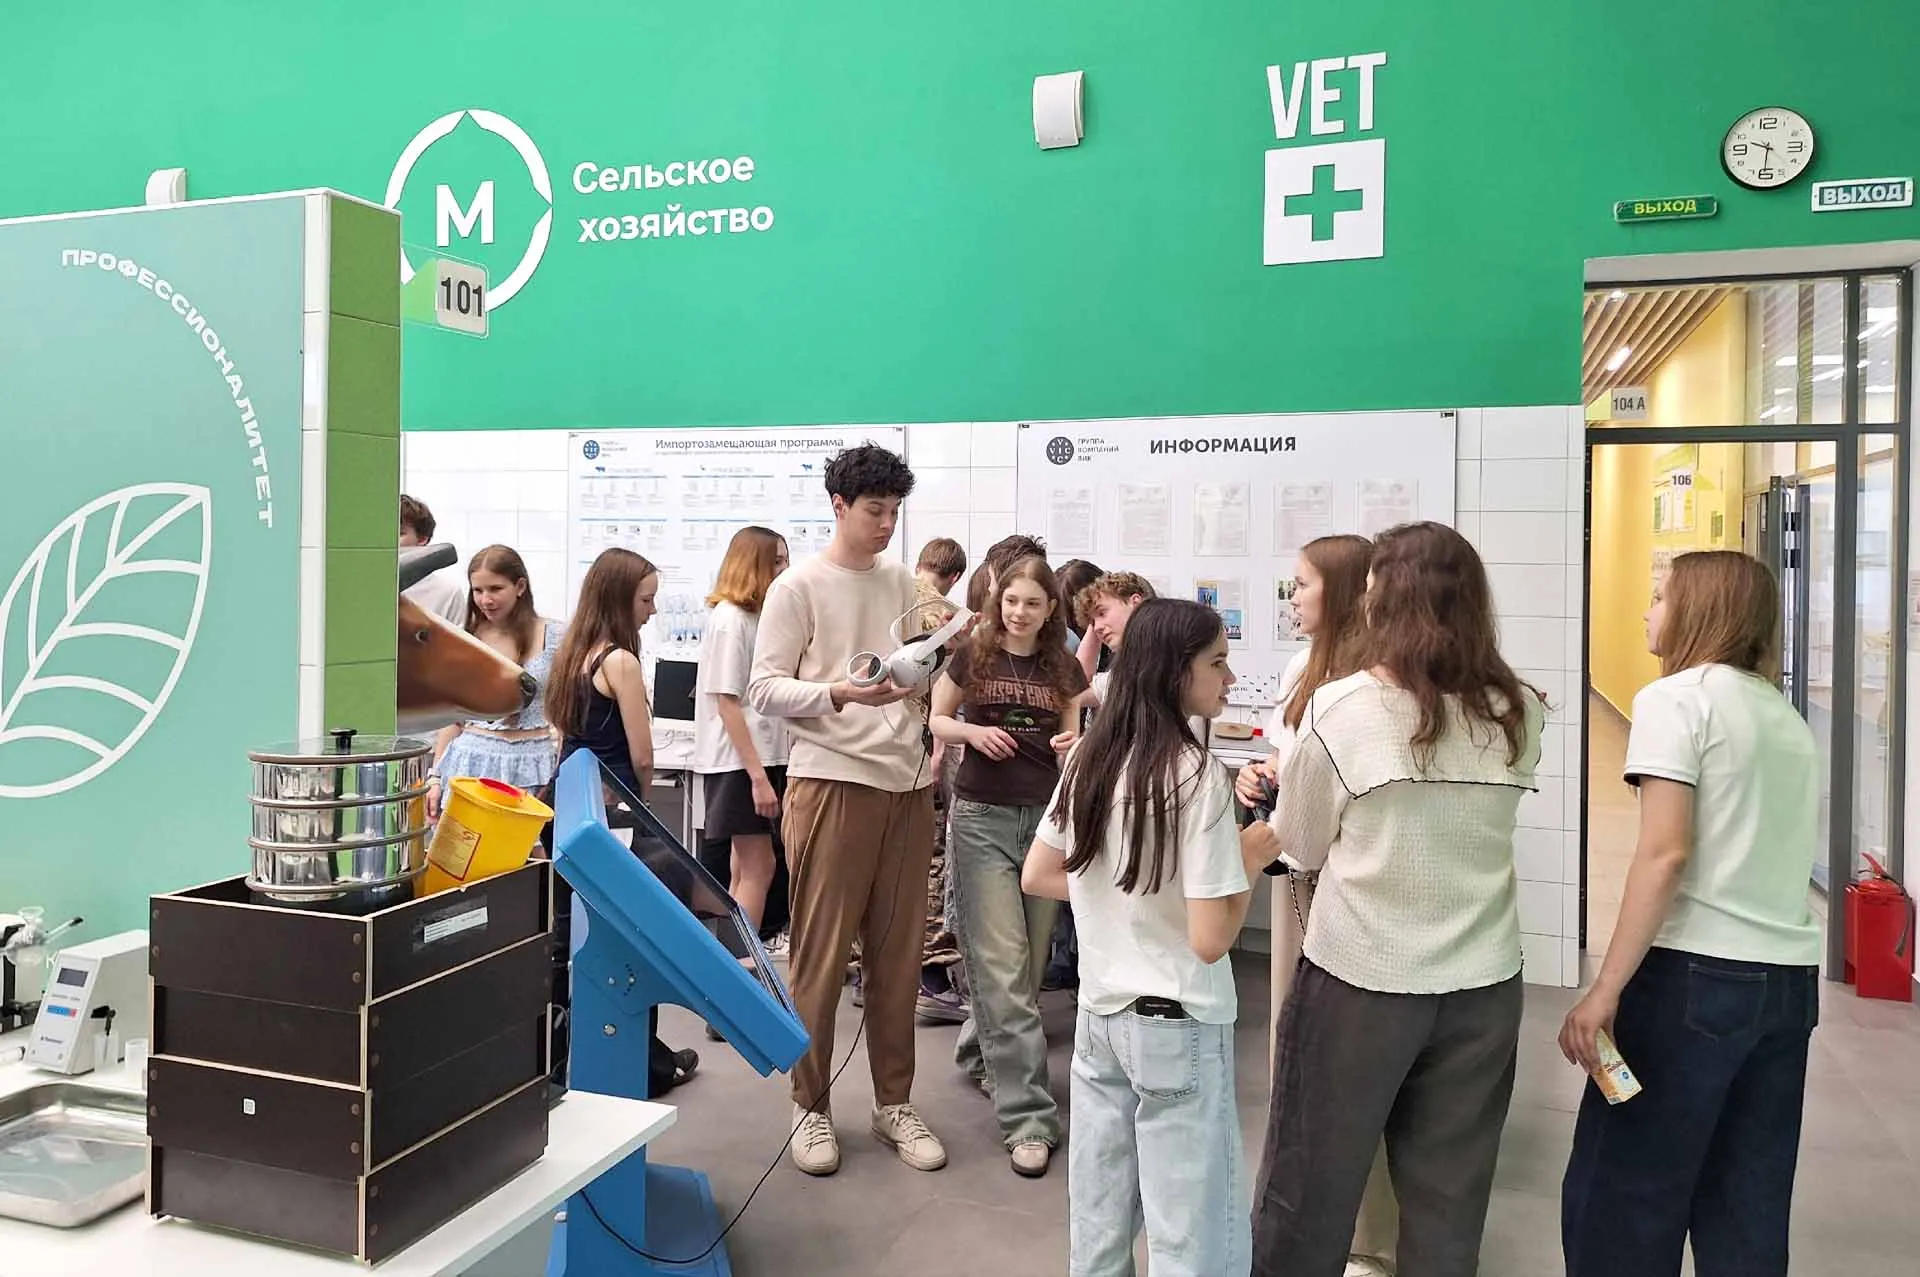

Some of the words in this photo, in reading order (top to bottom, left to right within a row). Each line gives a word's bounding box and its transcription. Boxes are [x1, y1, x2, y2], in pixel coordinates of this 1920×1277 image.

[1266, 51, 1387, 139] VET
[1760, 117, 1777, 130] 12
[1732, 144, 1747, 156] 9
[1787, 141, 1803, 153] 3
[572, 155, 755, 194] Сельское
[1758, 168, 1773, 179] 6
[1823, 183, 1904, 205] ВЫХОД
[435, 180, 495, 247] М
[1633, 199, 1697, 215] ВЫХОД
[577, 204, 774, 243] хозяйство
[440, 276, 484, 317] 101
[61, 249, 273, 528] ПРОФЕССИОНАЛИТЕТ
[1613, 397, 1634, 411] 104
[655, 439, 777, 449] Импортозамещающая
[780, 438, 844, 449] программа
[1150, 436, 1297, 454] ИНФОРМАЦИЯ
